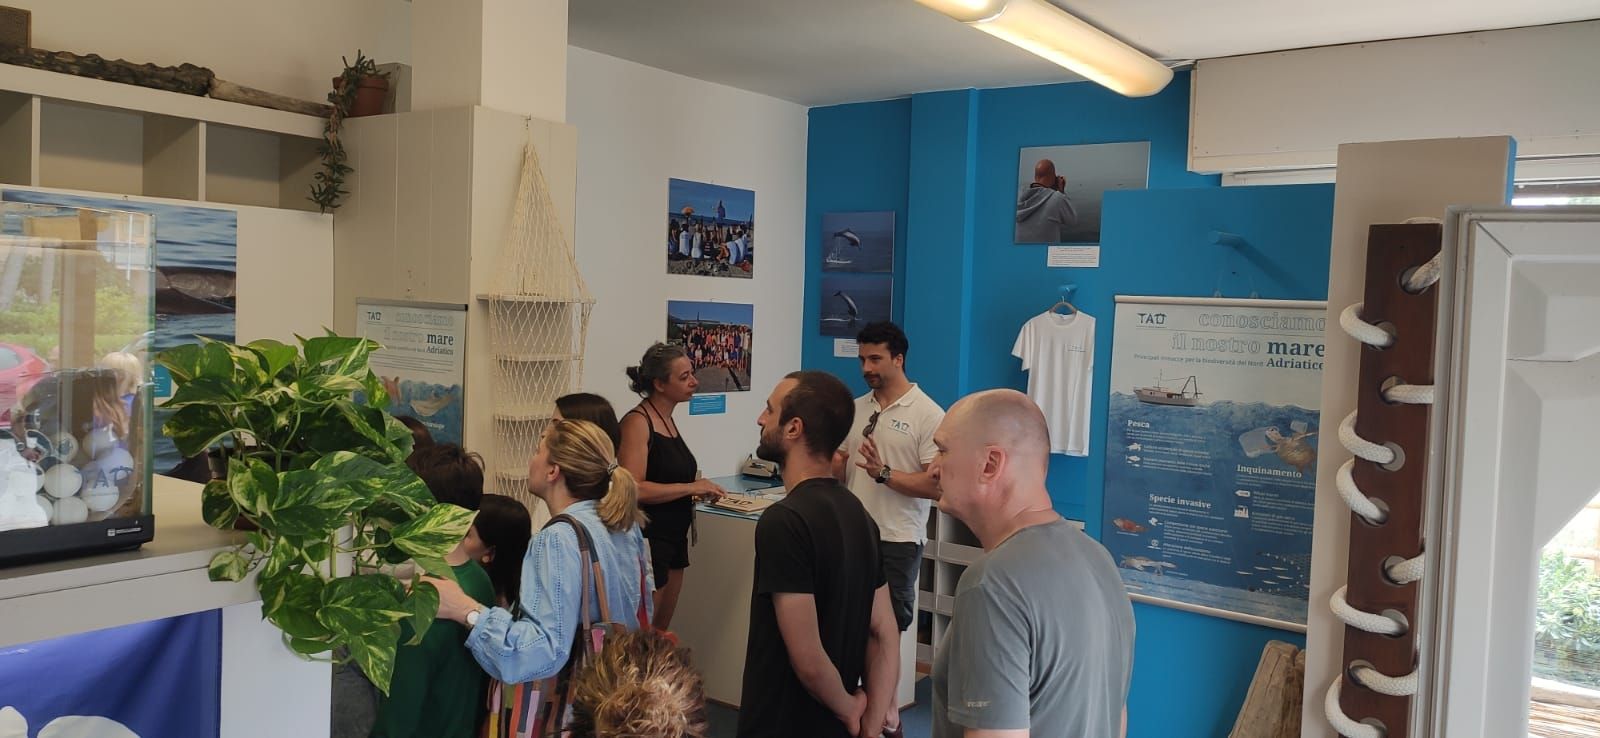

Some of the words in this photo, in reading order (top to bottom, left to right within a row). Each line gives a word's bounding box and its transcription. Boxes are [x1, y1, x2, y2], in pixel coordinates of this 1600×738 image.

[427, 333, 454, 346] mare
[1191, 336, 1262, 355] nostro
[1267, 341, 1325, 358] mare
[1127, 419, 1150, 429] Pesca
[1236, 464, 1303, 479] Inquinamento
[1149, 493, 1176, 504] Specie
[1177, 496, 1212, 509] invasive
